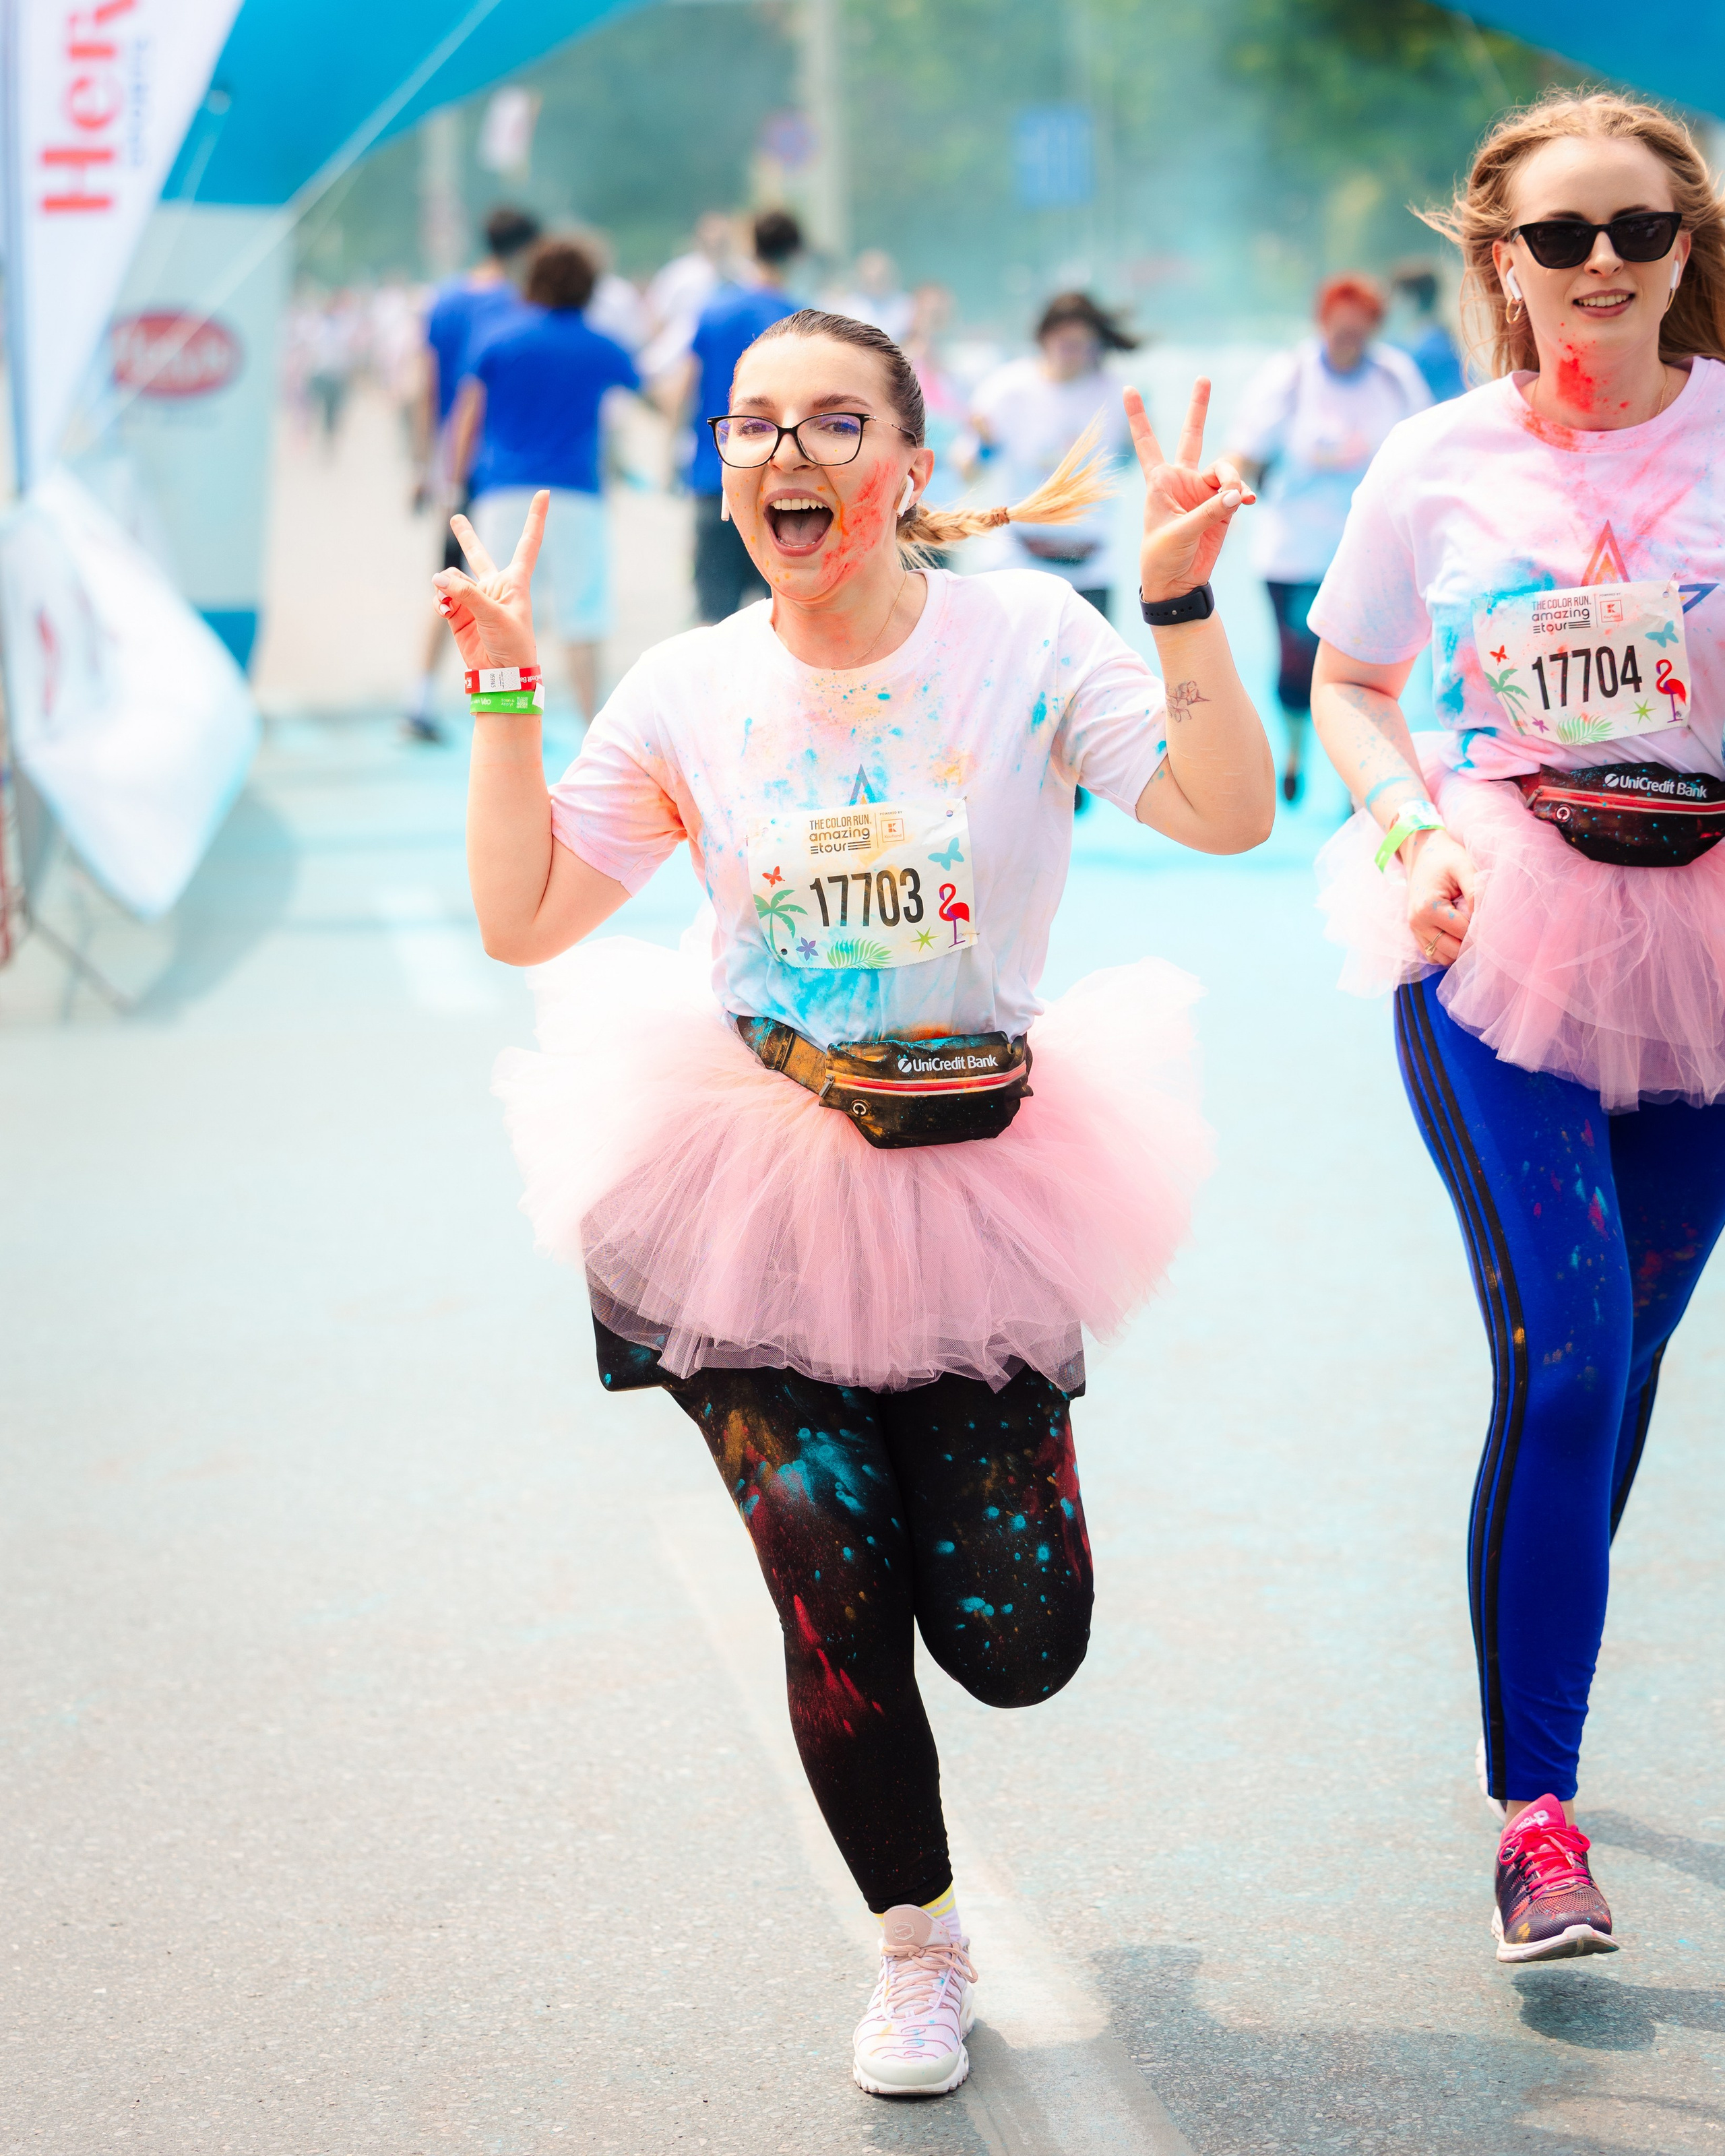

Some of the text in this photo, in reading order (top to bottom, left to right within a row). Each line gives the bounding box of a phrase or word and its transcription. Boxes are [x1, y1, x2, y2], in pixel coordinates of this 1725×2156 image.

[1532, 600, 1546, 611] THE
[1547, 597, 1573, 609] COLOR
[1532, 607, 1590, 622] amazing
[1541, 622, 1567, 633] tour
[1531, 645, 1643, 711] 17704
[1619, 775, 1708, 798] UniCredit Bank
[809, 819, 824, 831] THE
[825, 816, 852, 829] COLOR
[809, 827, 871, 842] amazing
[819, 842, 846, 854] tour
[809, 867, 924, 928] 17703
[912, 1054, 999, 1073] UniCredit Bank
